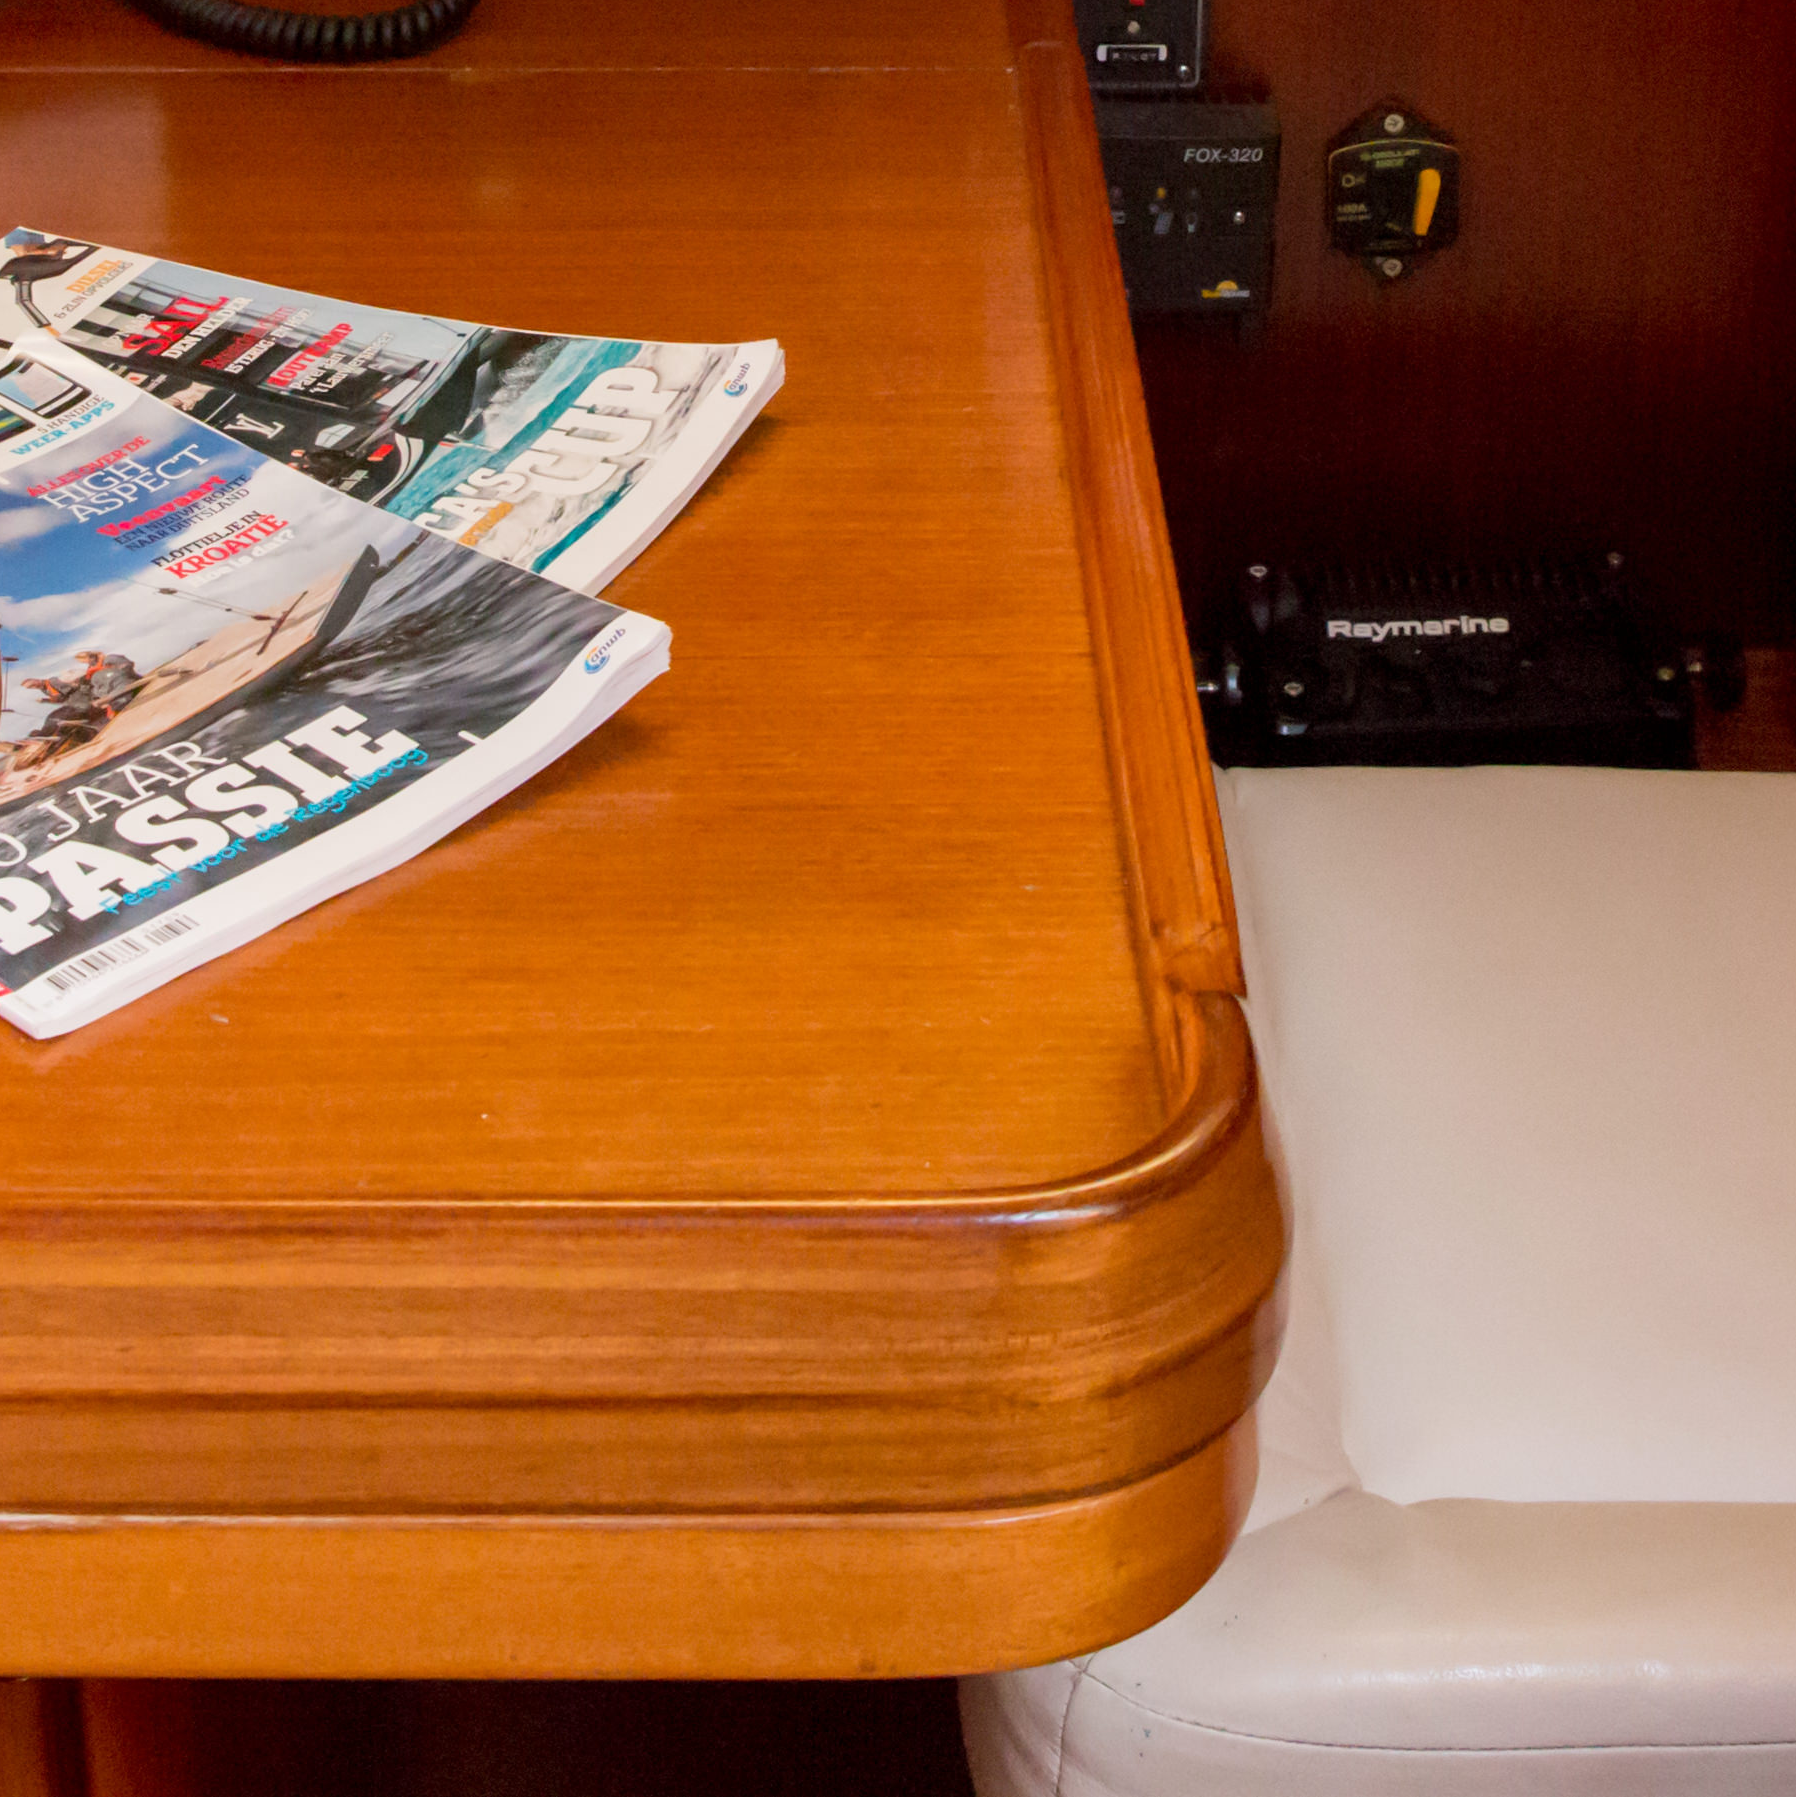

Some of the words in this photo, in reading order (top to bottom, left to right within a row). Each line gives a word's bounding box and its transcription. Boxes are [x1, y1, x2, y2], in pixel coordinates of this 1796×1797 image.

[1183, 147, 1264, 163] FOX-320
[66, 259, 123, 294] DIESEL
[122, 295, 231, 356] SAIL
[161, 334, 202, 359] DEN
[10, 399, 115, 455] WEER-APPS
[37, 426, 48, 434] 5
[48, 393, 106, 431] HANDIGE
[503, 365, 686, 497] CUP
[26, 469, 82, 497] ALLES
[78, 448, 129, 475] OVER
[122, 435, 152, 453] DE
[37, 457, 150, 511] HIGH
[68, 443, 209, 524] ASPECT
[114, 526, 152, 546] EEN
[149, 502, 207, 535] NIEUWE
[202, 473, 252, 507] ROUTE
[125, 525, 171, 553] NAAR
[165, 487, 251, 536] DUITSLAND
[150, 521, 246, 568] FLOTTIELJE
[240, 509, 262, 526] IN
[164, 513, 290, 580] KROATIË
[591, 628, 626, 663] anwb
[1326, 614, 1510, 643] Raymarine
[33, 740, 229, 842] JAAR
[98, 866, 184, 915] Feest
[187, 836, 249, 874] voor
[254, 820, 290, 843] de
[283, 746, 429, 823] Regenboog
